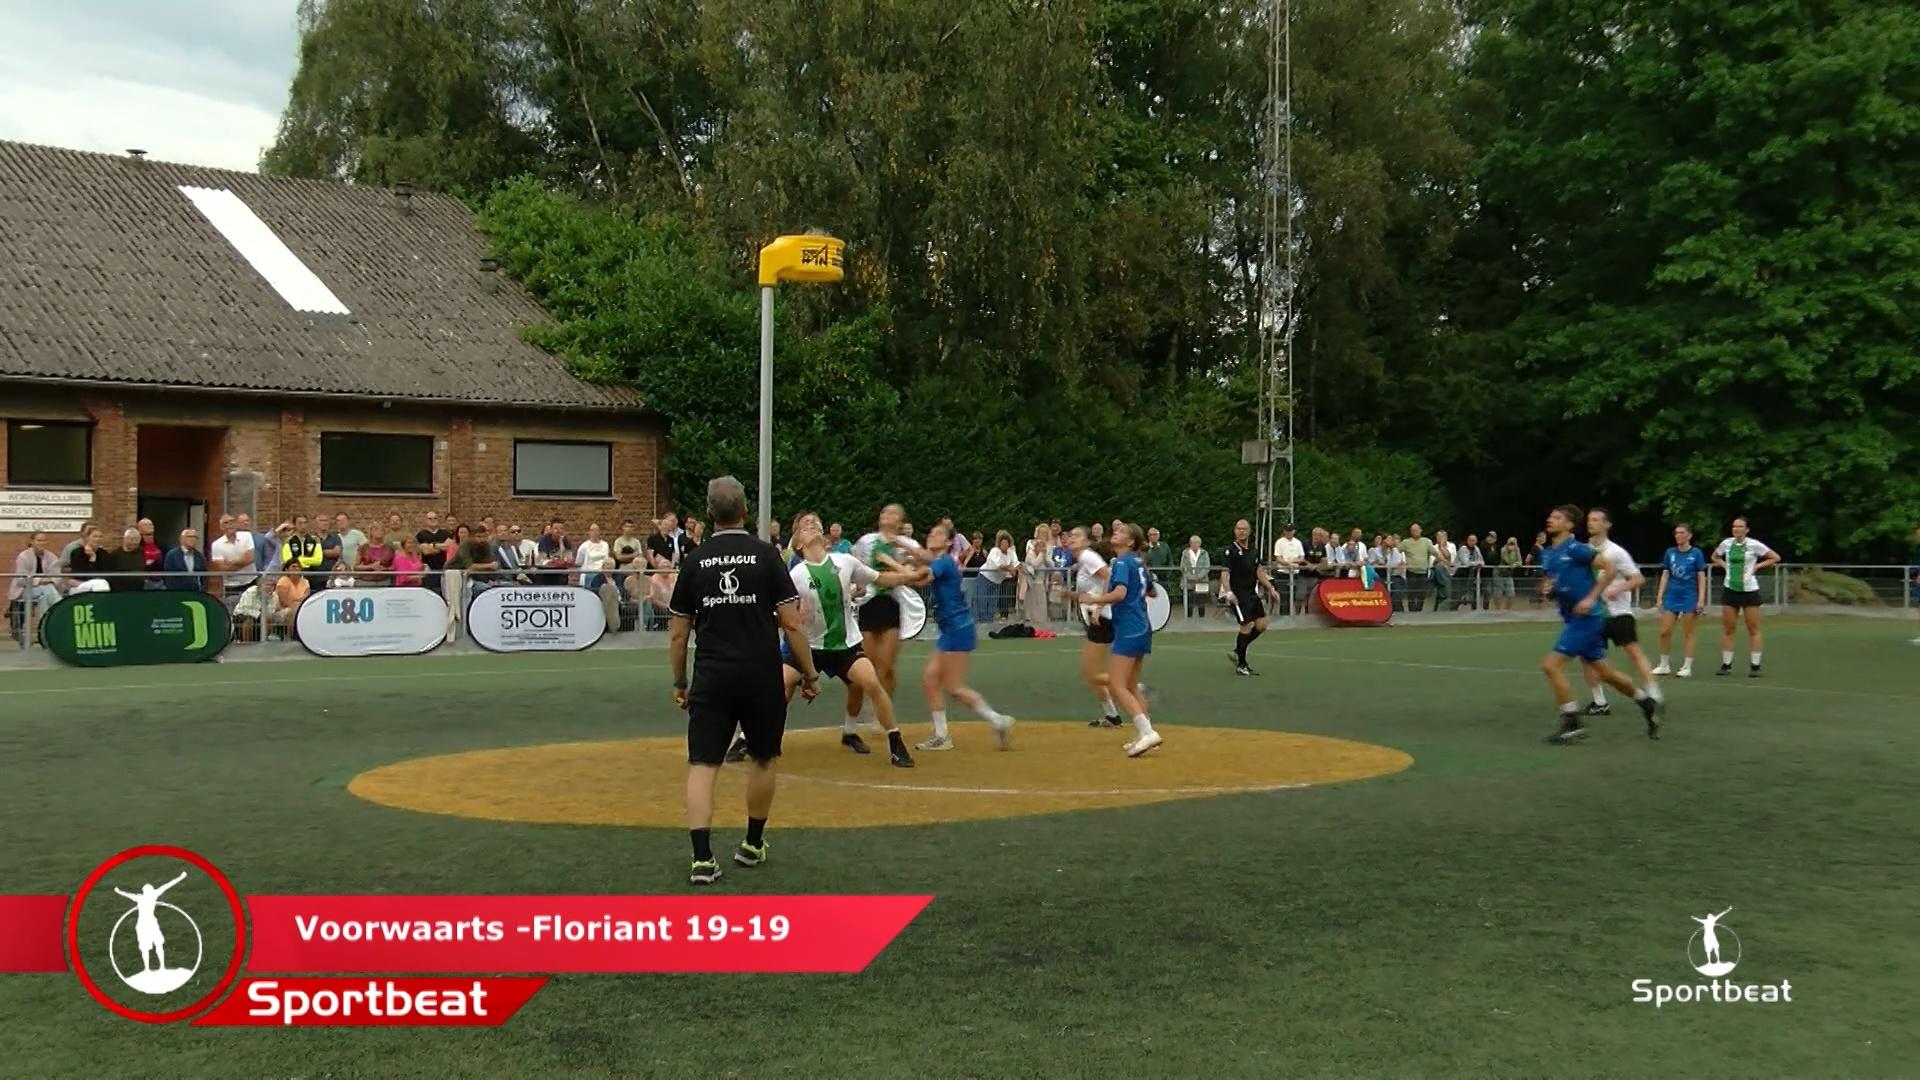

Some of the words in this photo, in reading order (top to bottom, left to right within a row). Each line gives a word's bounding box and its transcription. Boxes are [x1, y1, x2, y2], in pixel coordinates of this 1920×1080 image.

[699, 555, 757, 568] TOPLEAGUE
[501, 591, 576, 602] schaessens
[702, 593, 757, 608] Sportbeat
[73, 604, 95, 624] DE
[326, 597, 374, 624] R&O
[501, 606, 569, 630] SPORT
[75, 622, 117, 648] WIN
